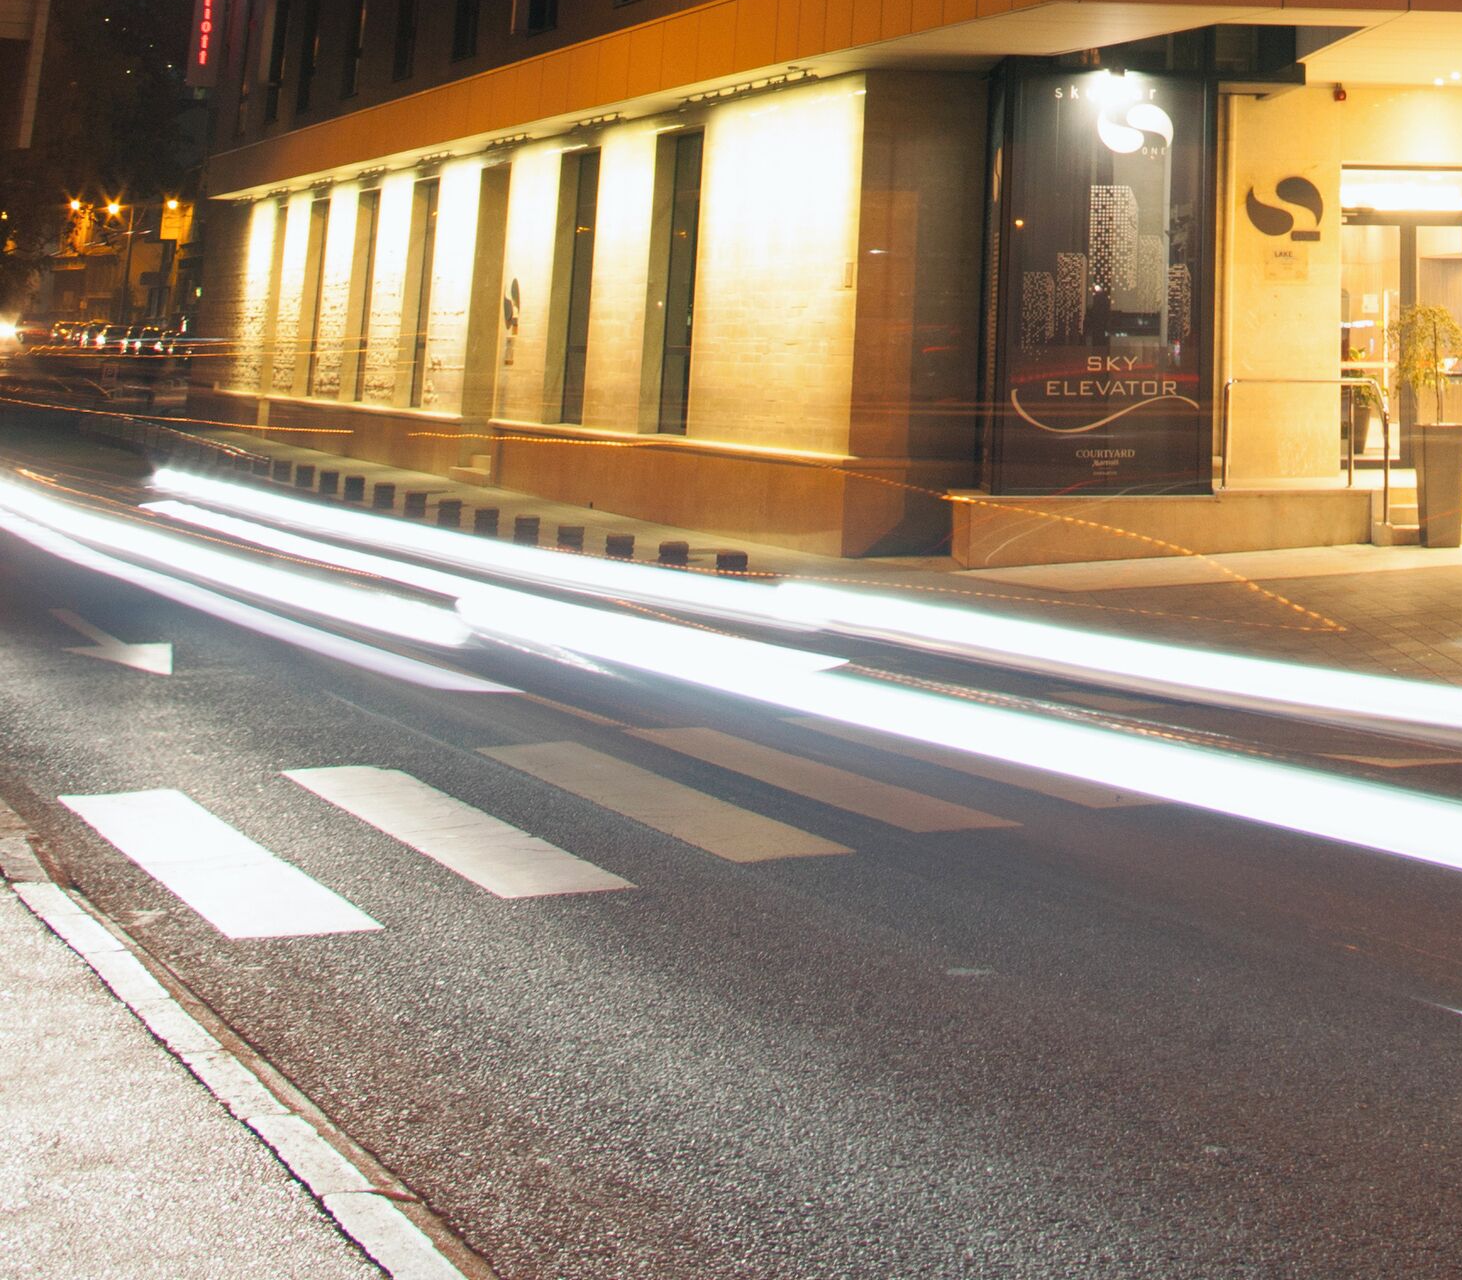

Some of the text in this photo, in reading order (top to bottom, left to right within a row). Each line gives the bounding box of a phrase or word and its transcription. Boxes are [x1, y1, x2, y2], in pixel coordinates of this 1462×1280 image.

[1086, 356, 1138, 371] SKY
[1046, 380, 1177, 396] ELEVATOR
[1075, 449, 1136, 458] COURTYARD
